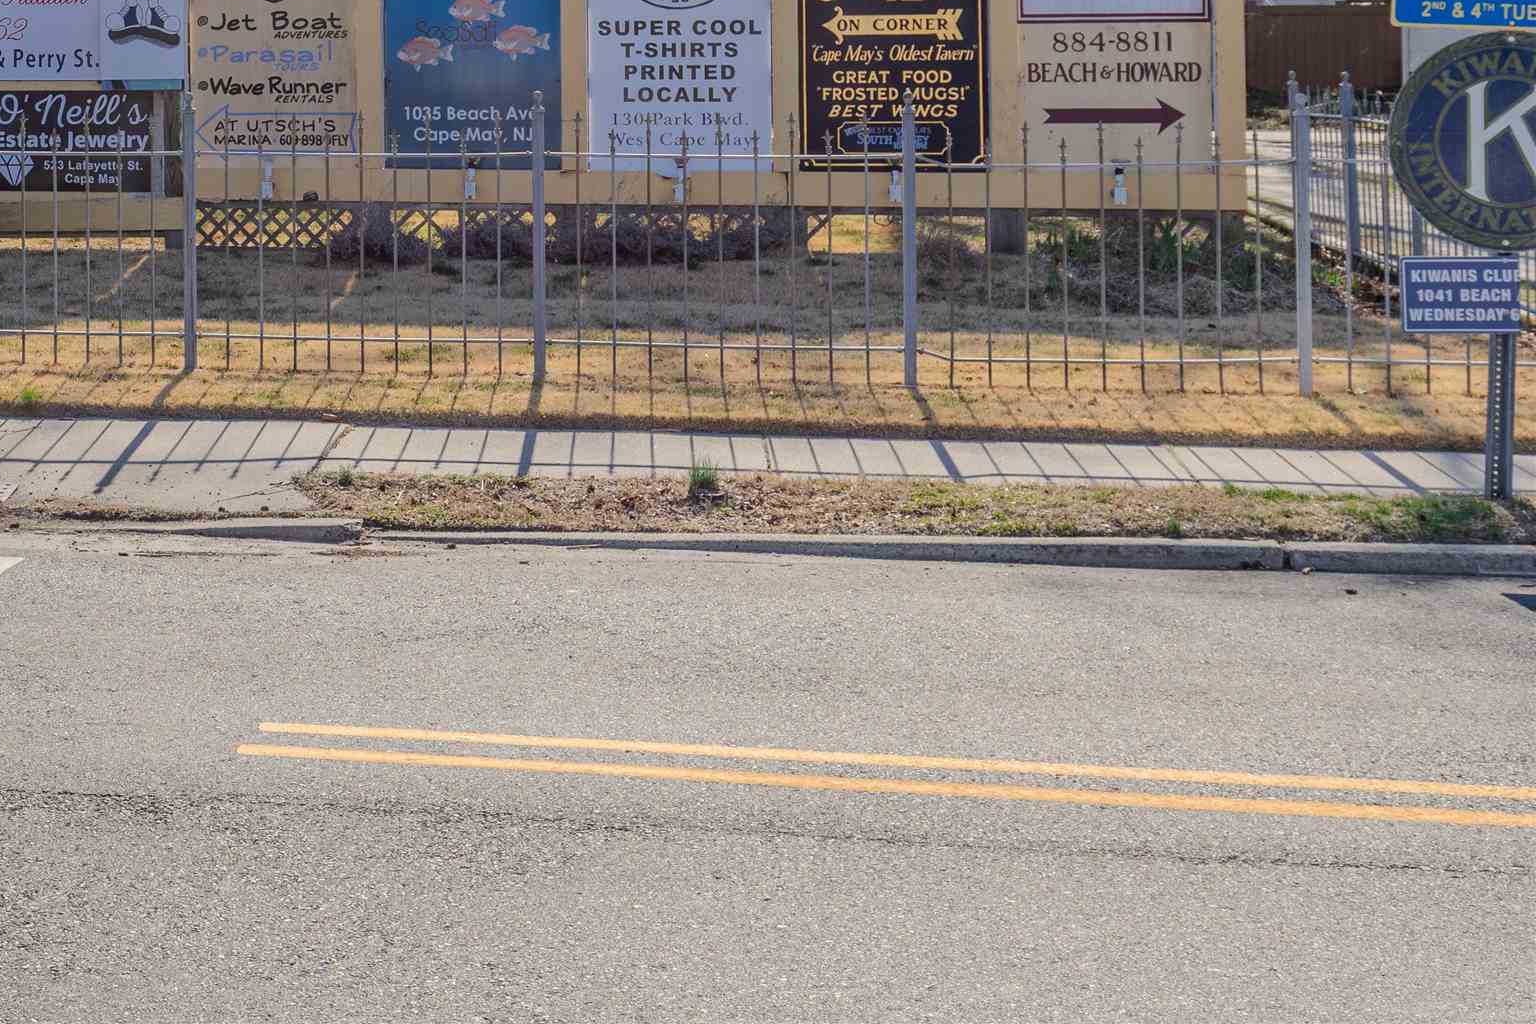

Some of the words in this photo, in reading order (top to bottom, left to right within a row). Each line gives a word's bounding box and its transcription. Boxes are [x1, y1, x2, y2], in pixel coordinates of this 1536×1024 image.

[1452, 2, 1465, 18] &
[210, 13, 257, 31] Jet
[271, 10, 343, 31] Boat
[598, 20, 682, 36] SUPER
[692, 20, 762, 36] COOL
[837, 19, 860, 32] ON
[872, 18, 948, 31] CORNER
[273, 30, 348, 40] ADVENTURES
[1052, 31, 1173, 53] 884-8811
[210, 40, 334, 64] Parasail
[620, 42, 739, 58] T-SHIRTS
[844, 44, 884, 65] May's
[889, 44, 932, 61] Oldest
[13, 49, 66, 73] Perry
[74, 48, 101, 68] St.
[624, 64, 736, 80] PRINTED
[832, 70, 890, 84] GREAT
[902, 70, 952, 84] FOOD
[1027, 63, 1097, 83] BEACH
[1100, 64, 1114, 80] &
[1116, 61, 1202, 83] HOWARD
[210, 76, 265, 96] Wave
[268, 76, 347, 95] Runner
[274, 95, 335, 104] RENTALS
[623, 86, 737, 103] LOCALLY
[404, 106, 441, 121] 1035
[447, 106, 500, 121] Beach
[828, 104, 884, 117] BEST
[215, 119, 239, 132] AT
[247, 117, 336, 132] UTSCH'S
[653, 112, 694, 126] Park
[65, 129, 149, 152] Jewelry
[214, 134, 273, 146] MARINA
[414, 127, 460, 144] Cape
[514, 127, 534, 141] NJ
[1466, 80, 1536, 203] K
[127, 160, 144, 171] St.
[64, 174, 95, 186] Cape
[98, 174, 121, 186] May
[1410, 269, 1477, 282] KIWANIS
[1416, 289, 1453, 302] 1041
[1460, 289, 1511, 302] BEACH
[1409, 308, 1505, 321] WEDNESDAY
